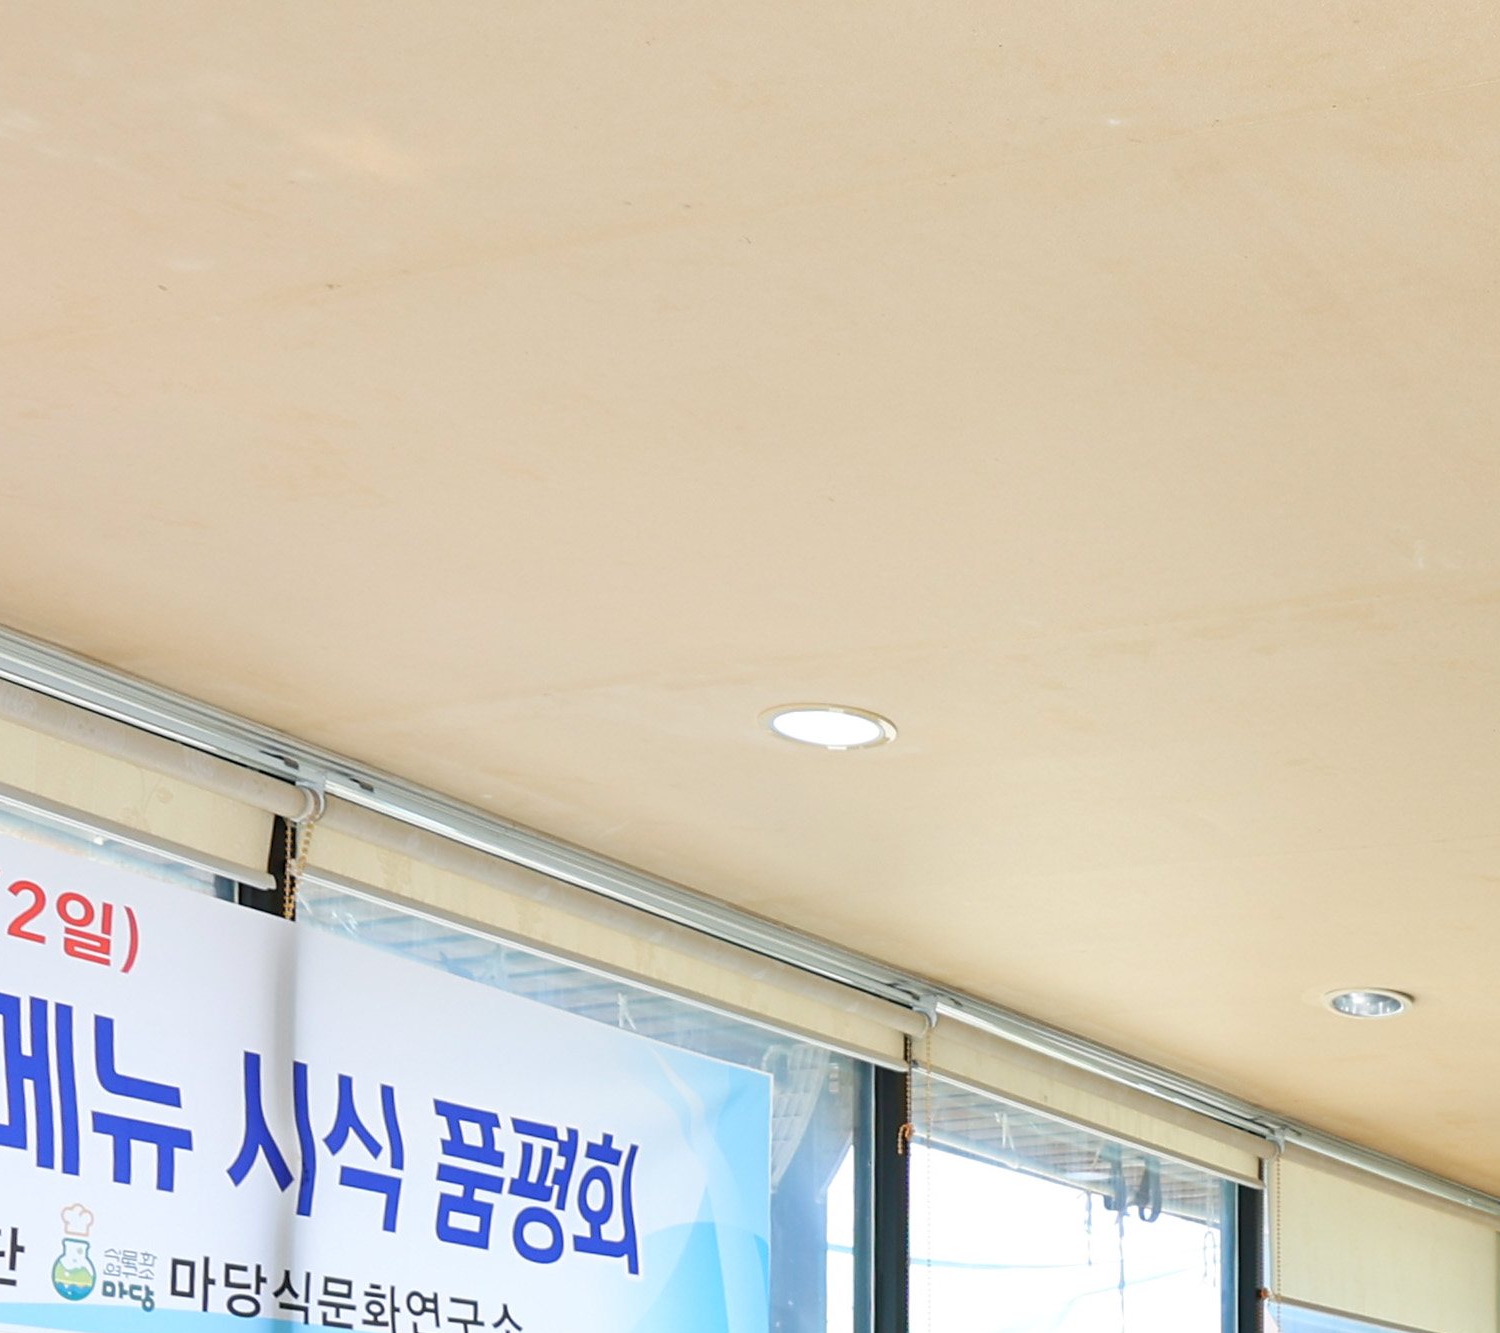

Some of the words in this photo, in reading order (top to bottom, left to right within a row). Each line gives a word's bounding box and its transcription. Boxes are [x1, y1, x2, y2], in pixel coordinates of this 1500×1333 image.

[226, 1050, 405, 1234] 시식
[432, 1098, 641, 1277] 품평회
[102, 1280, 155, 1312] 마당
